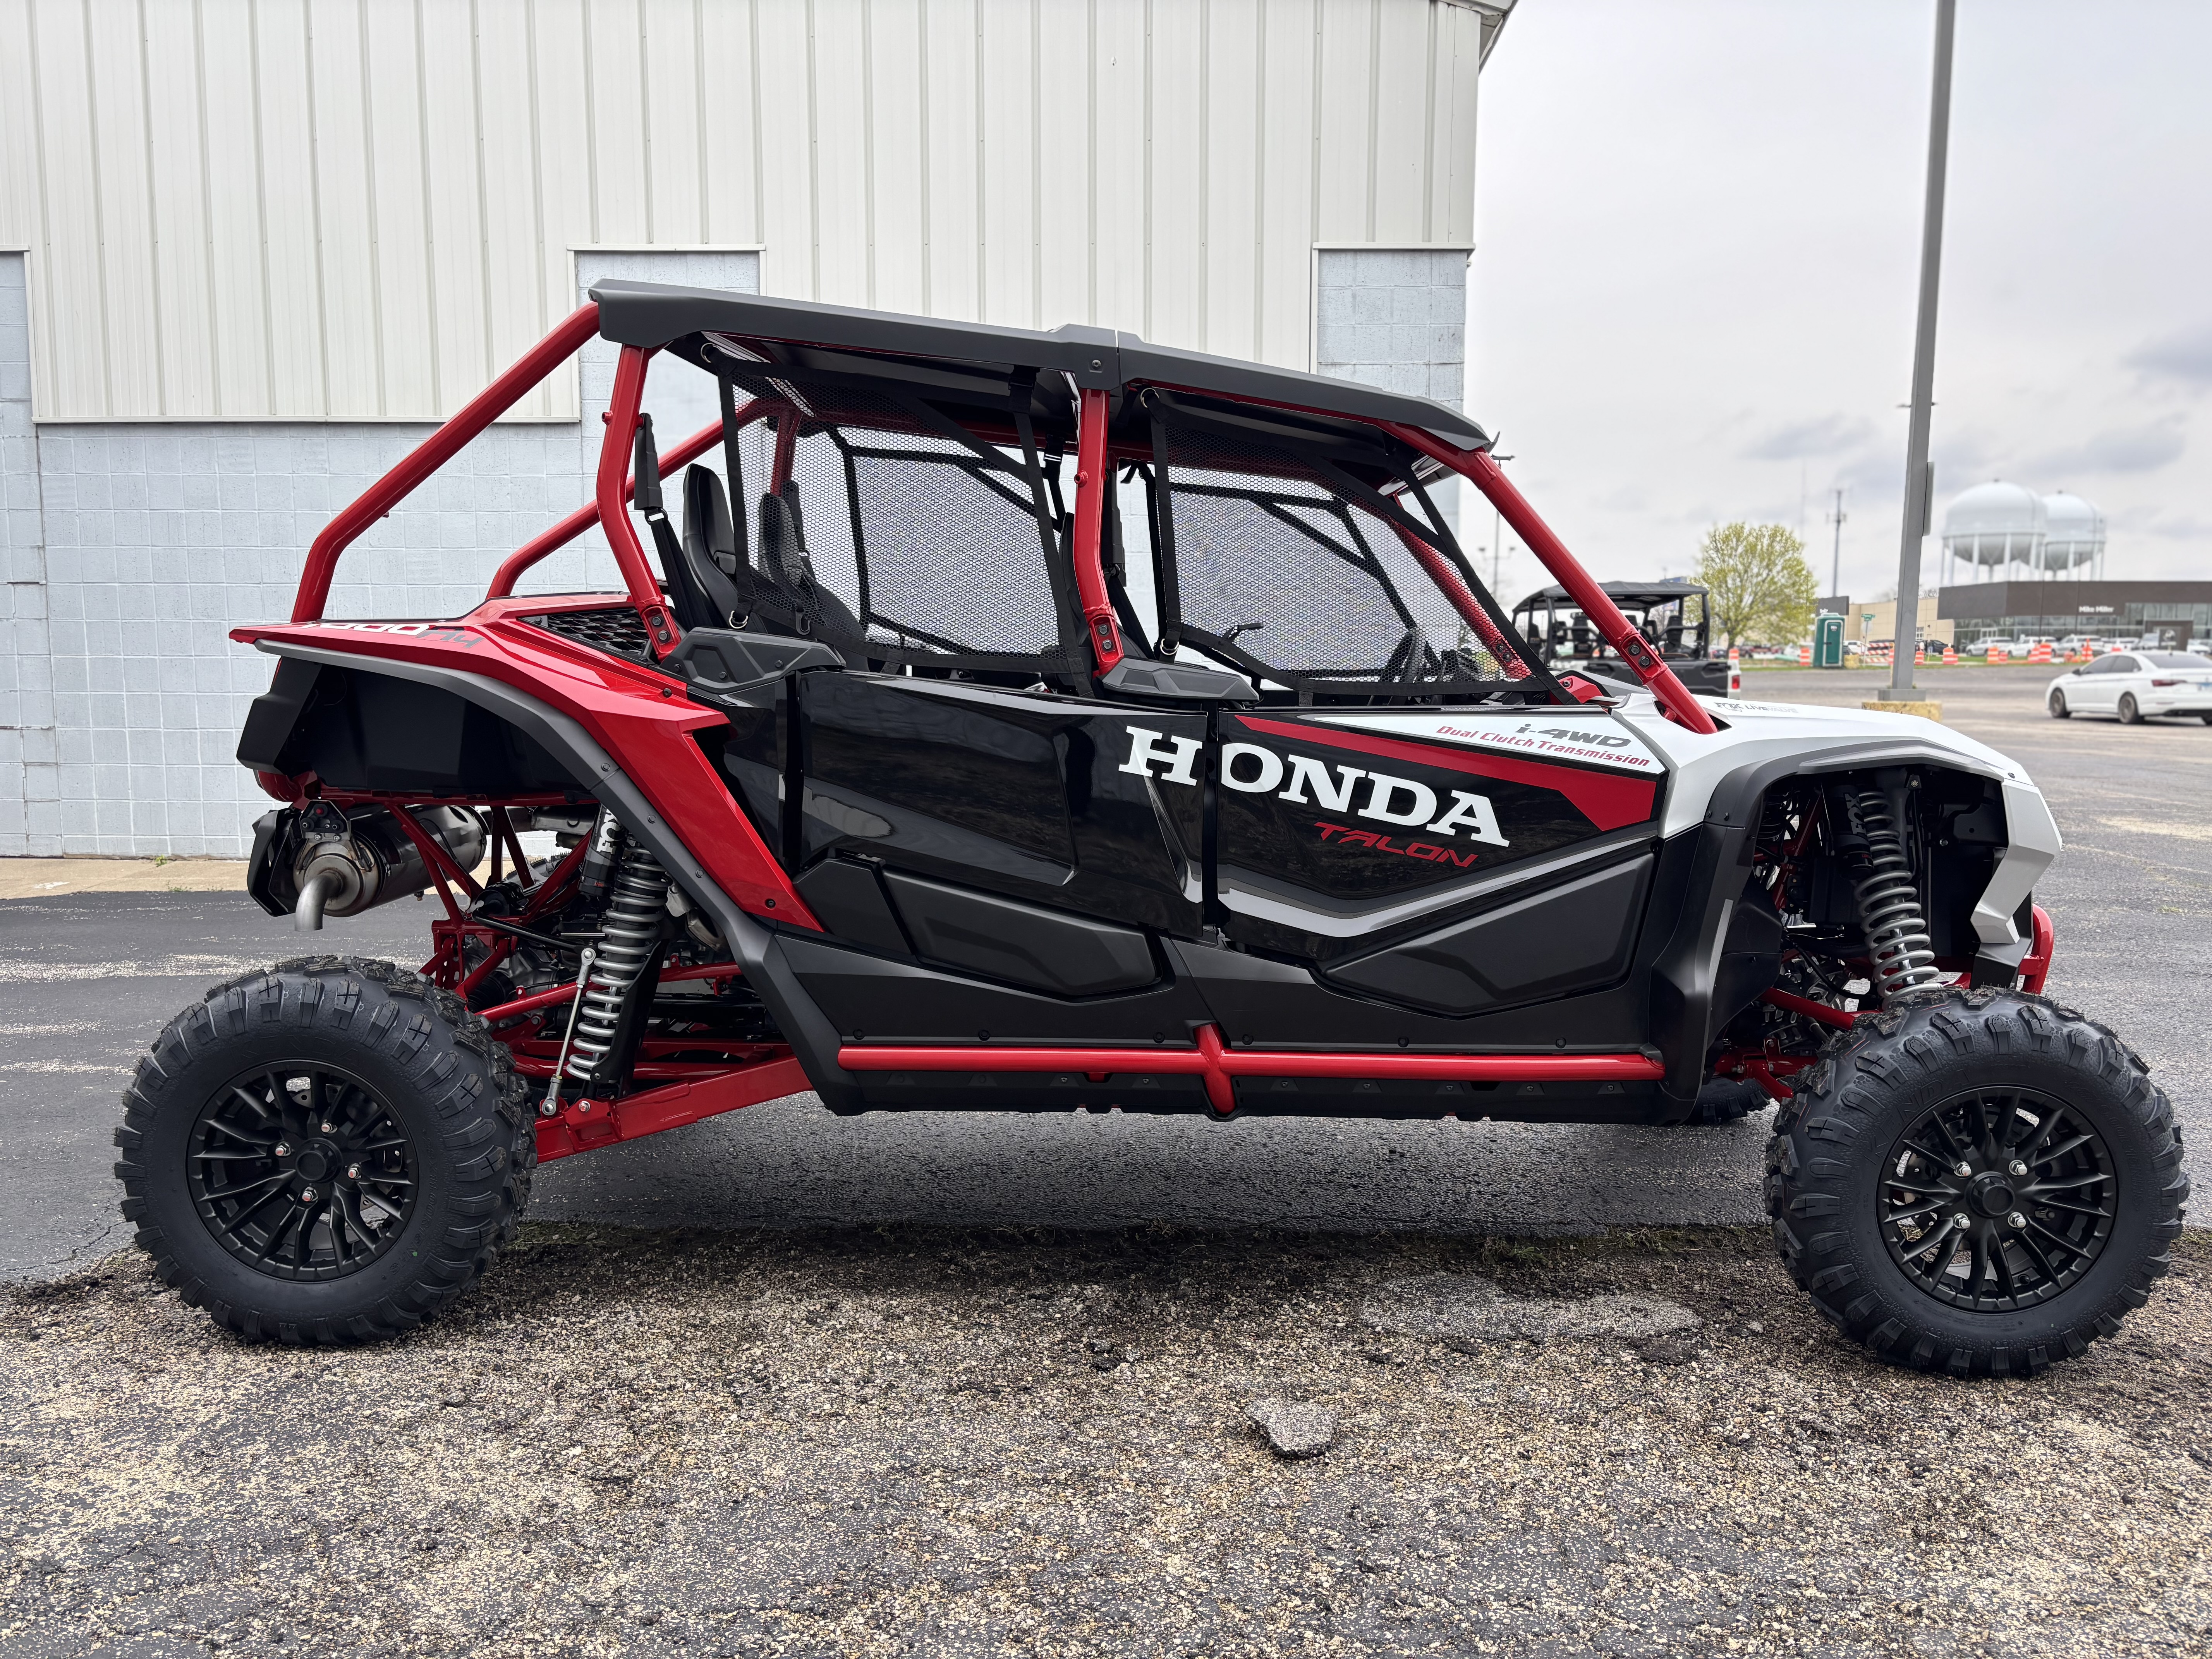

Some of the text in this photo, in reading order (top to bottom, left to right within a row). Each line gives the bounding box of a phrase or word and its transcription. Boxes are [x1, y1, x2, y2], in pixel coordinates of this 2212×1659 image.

[1436, 726, 1650, 766] Dual Clutch Transmission
[1516, 723, 1632, 748] i-4WD
[1118, 725, 1510, 847] HONDA
[1314, 822, 1479, 867] TALON
[1863, 1068, 1971, 1166] KENDA
